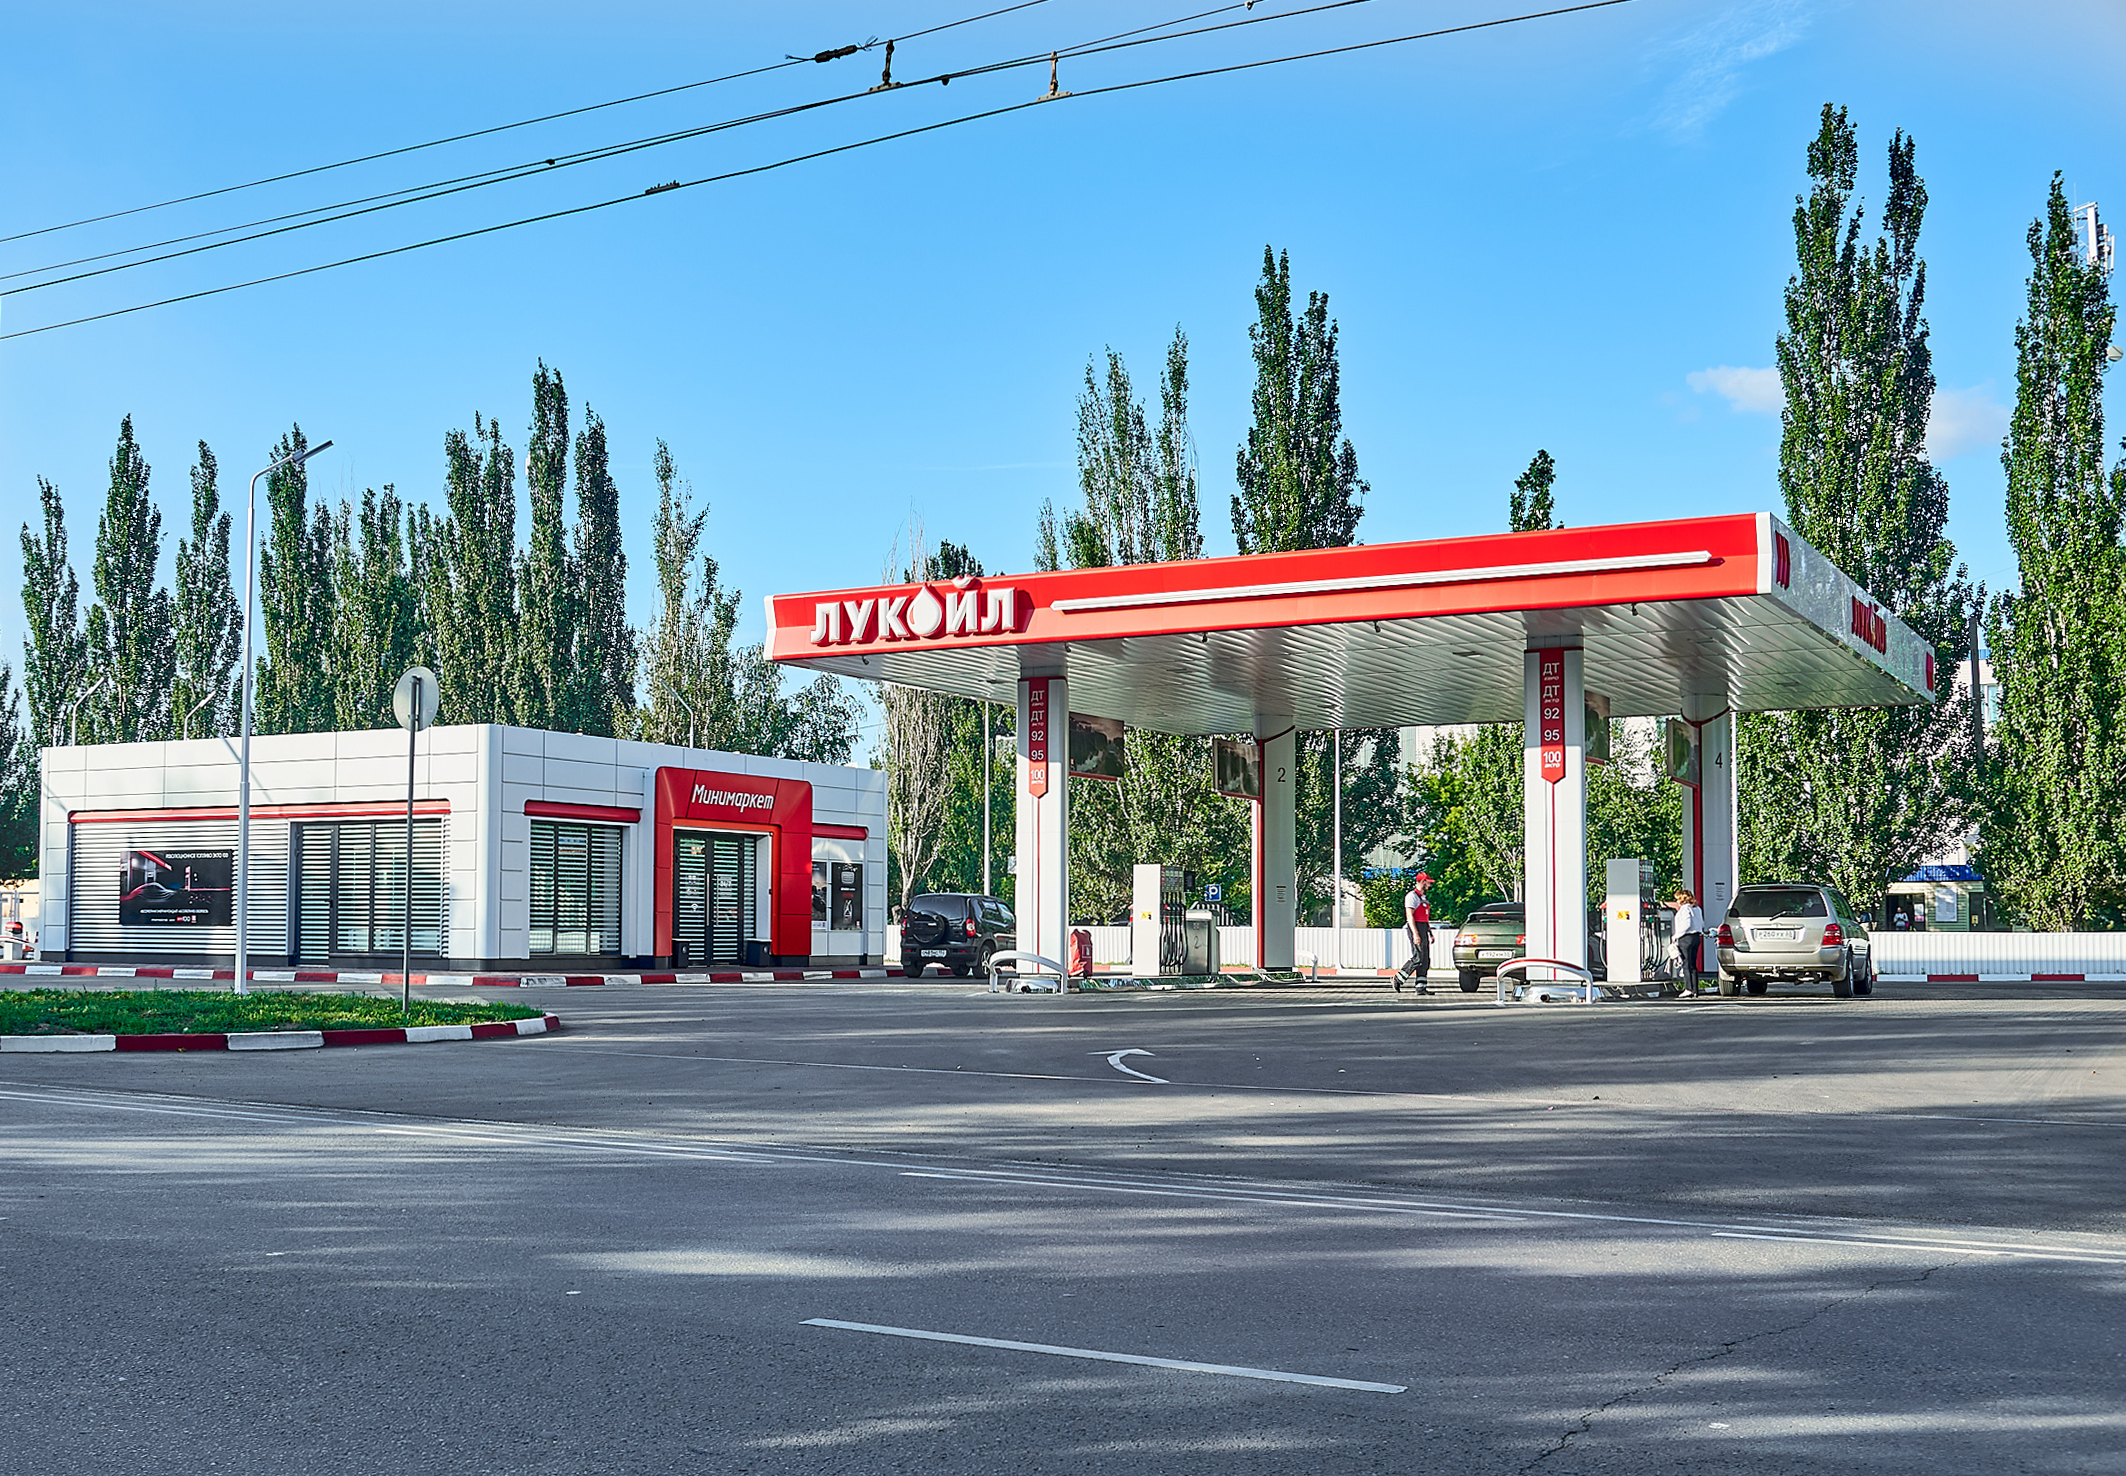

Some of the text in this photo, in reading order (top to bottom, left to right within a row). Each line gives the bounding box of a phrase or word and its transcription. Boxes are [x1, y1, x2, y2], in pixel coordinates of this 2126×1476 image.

[810, 574, 1016, 644] ЛУКОЙЛ
[1543, 662, 1560, 676] ДТ
[1031, 690, 1044, 702] ДТ
[1543, 685, 1560, 698] ДТ
[1031, 710, 1044, 722] ДТ
[1544, 708, 1560, 720] 92
[1031, 730, 1044, 742] 92
[1544, 729, 1560, 741] 95
[1031, 750, 1044, 760] 95
[1543, 750, 1562, 763] 100
[1715, 752, 1723, 768] 4
[1030, 769, 1044, 780] 100
[1277, 767, 1286, 782] 2
[692, 784, 774, 813] Минимаркет
